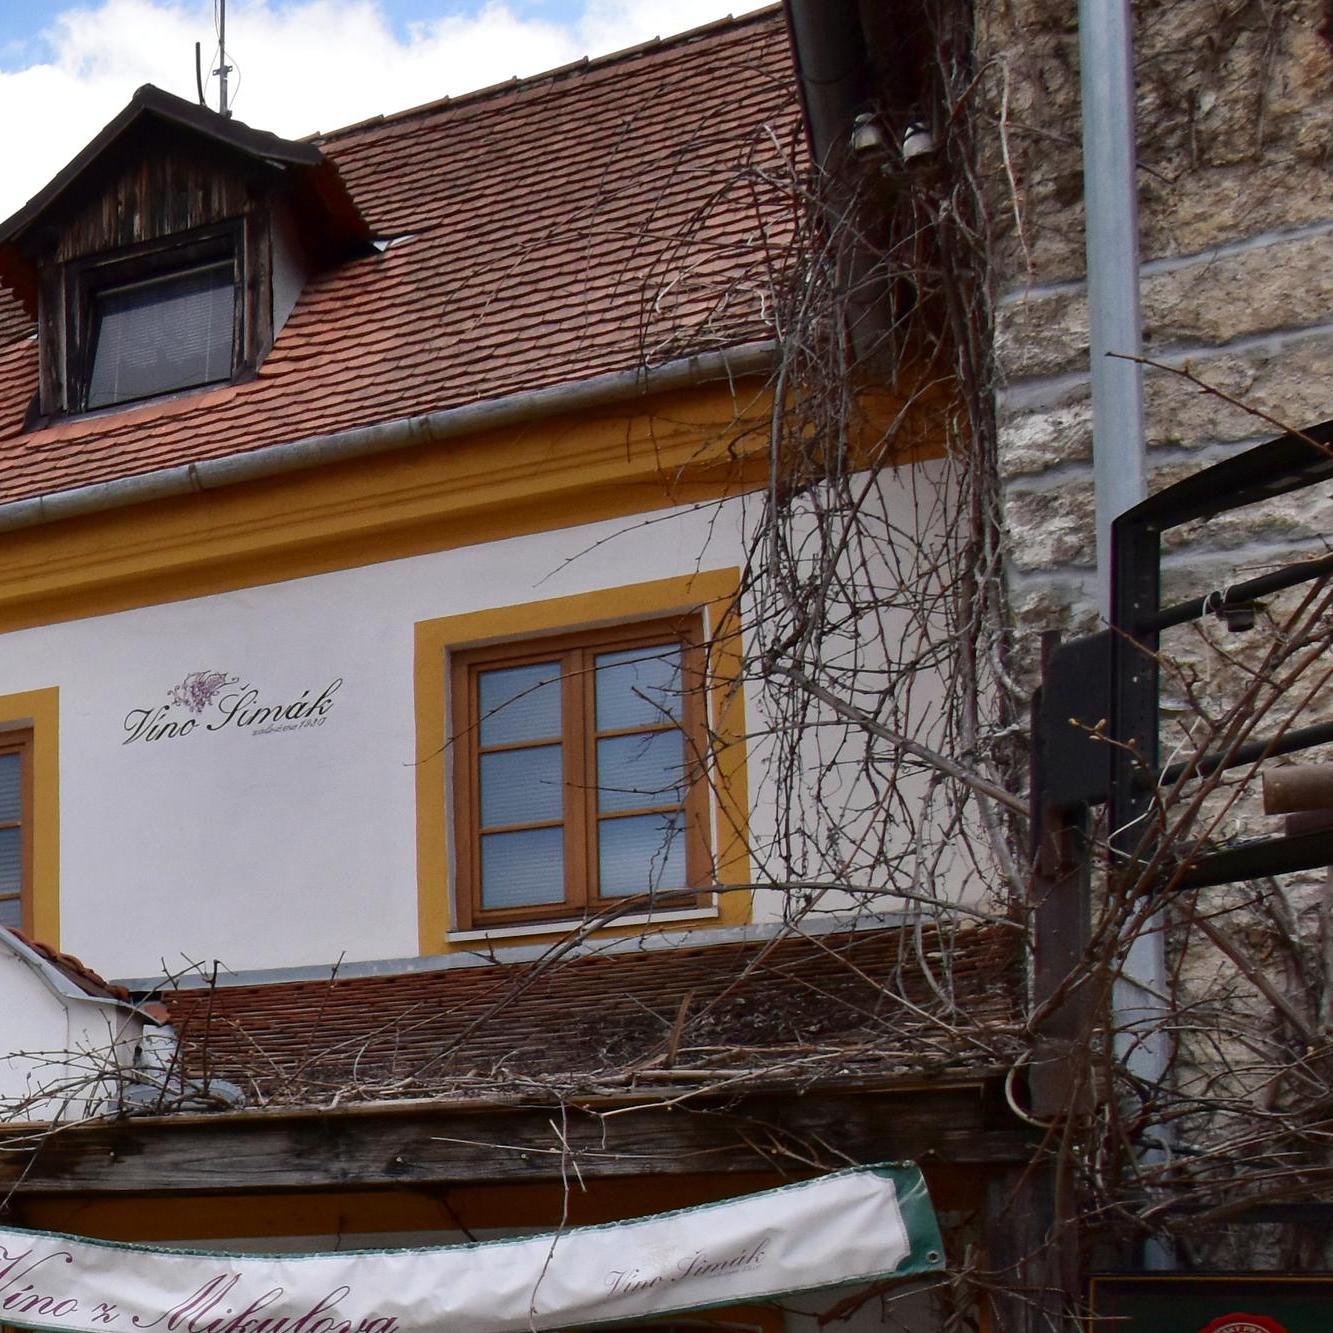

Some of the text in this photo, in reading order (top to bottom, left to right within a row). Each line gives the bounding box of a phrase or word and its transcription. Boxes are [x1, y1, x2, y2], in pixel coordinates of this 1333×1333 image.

[122, 677, 343, 745] Víno Šimák
[92, 1300, 120, 1323] z
